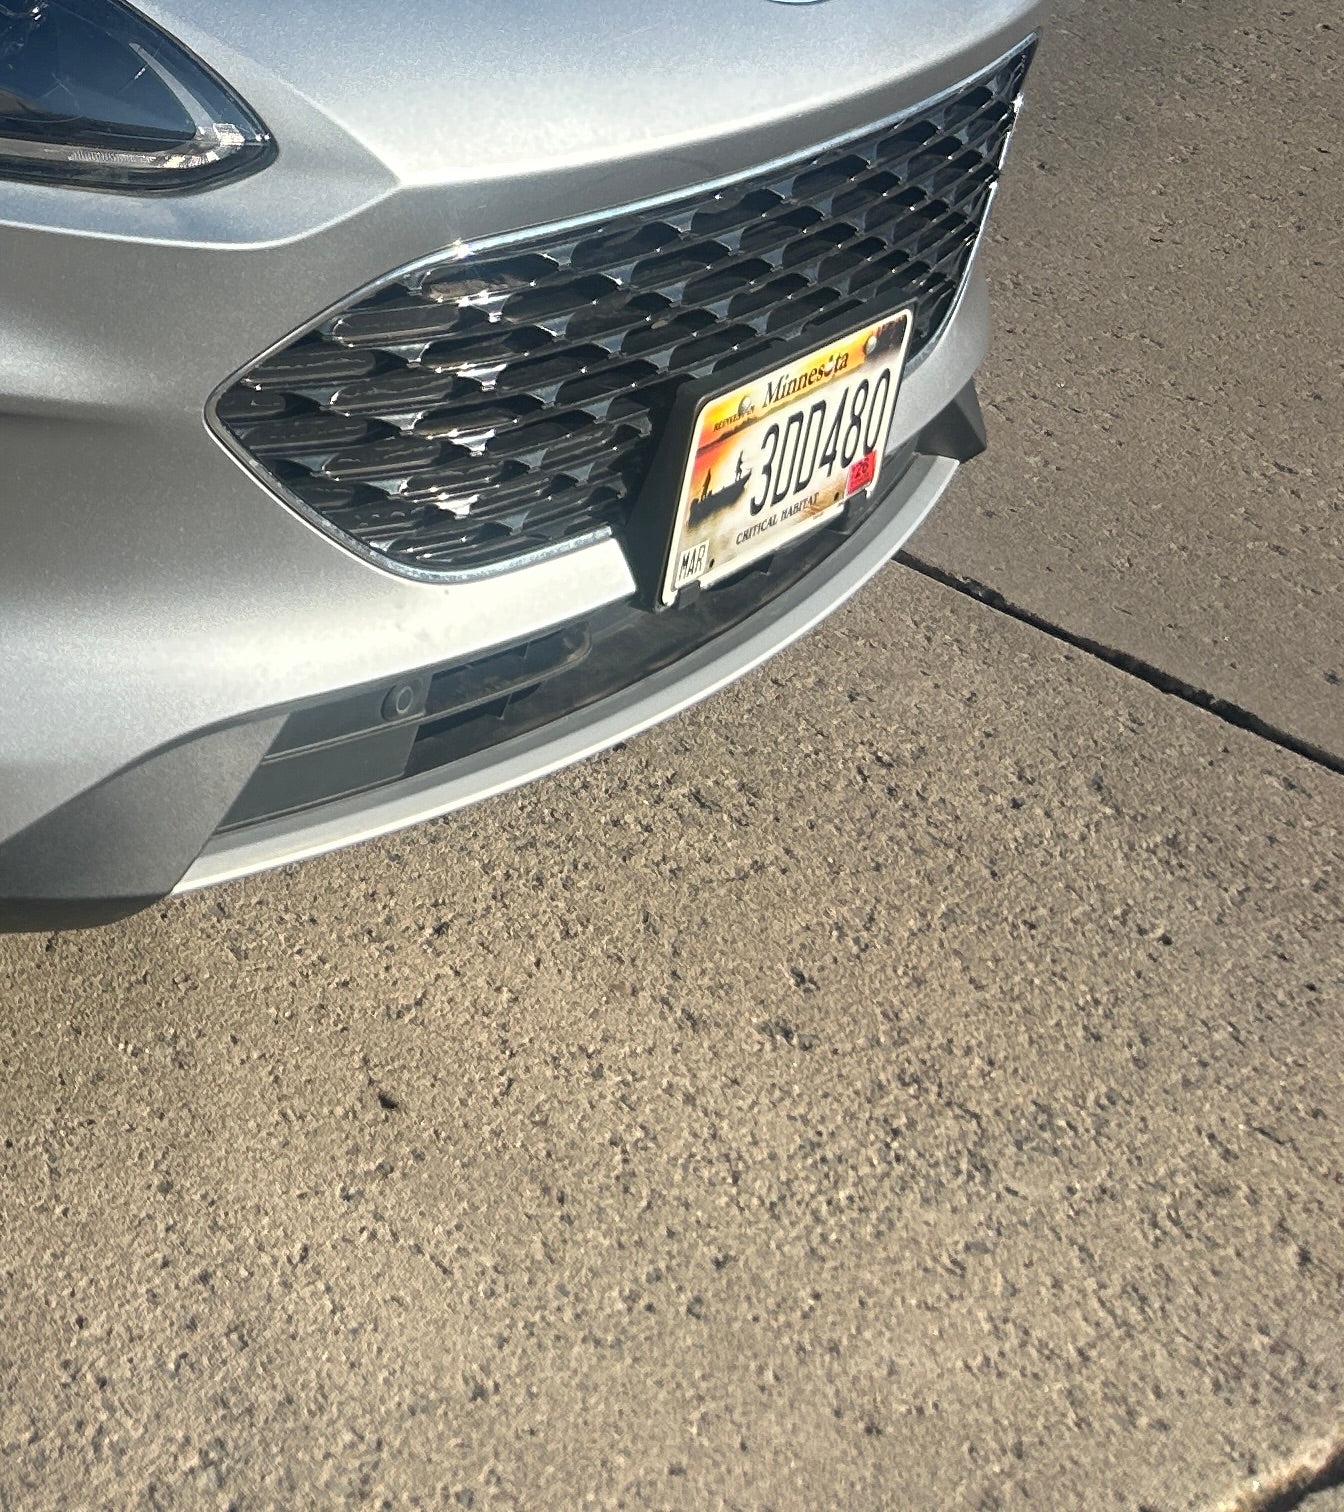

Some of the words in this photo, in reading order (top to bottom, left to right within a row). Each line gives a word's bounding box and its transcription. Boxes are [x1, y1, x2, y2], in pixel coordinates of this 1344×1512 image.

[750, 367, 891, 516] 3DD480
[736, 515, 778, 545] CRITICAL
[781, 492, 820, 526] HABITAT
[679, 545, 706, 580] MAR
